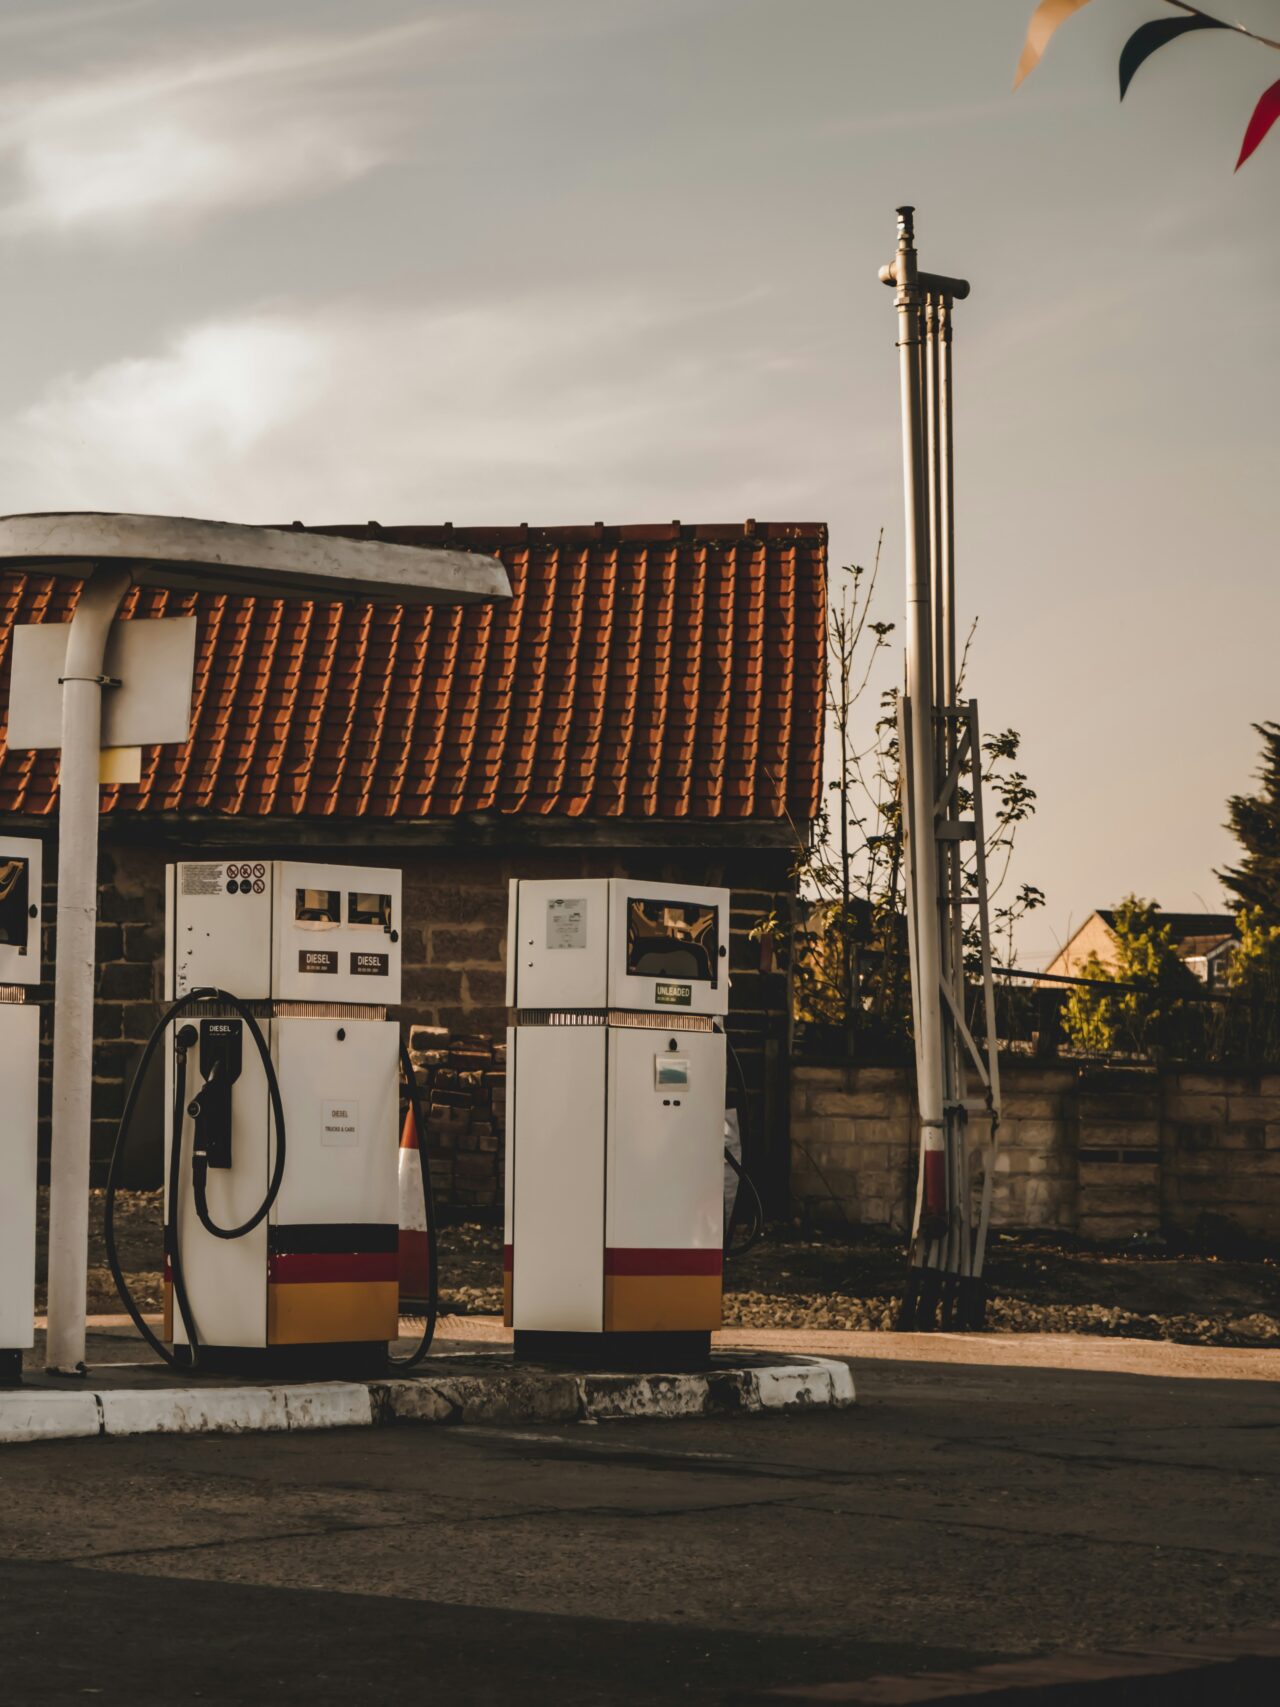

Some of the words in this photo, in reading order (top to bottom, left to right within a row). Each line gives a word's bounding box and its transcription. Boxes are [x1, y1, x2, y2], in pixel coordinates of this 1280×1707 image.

[306, 953, 331, 964] DIESEL
[357, 955, 382, 966] DIESEL
[657, 986, 690, 997] UNLEADED
